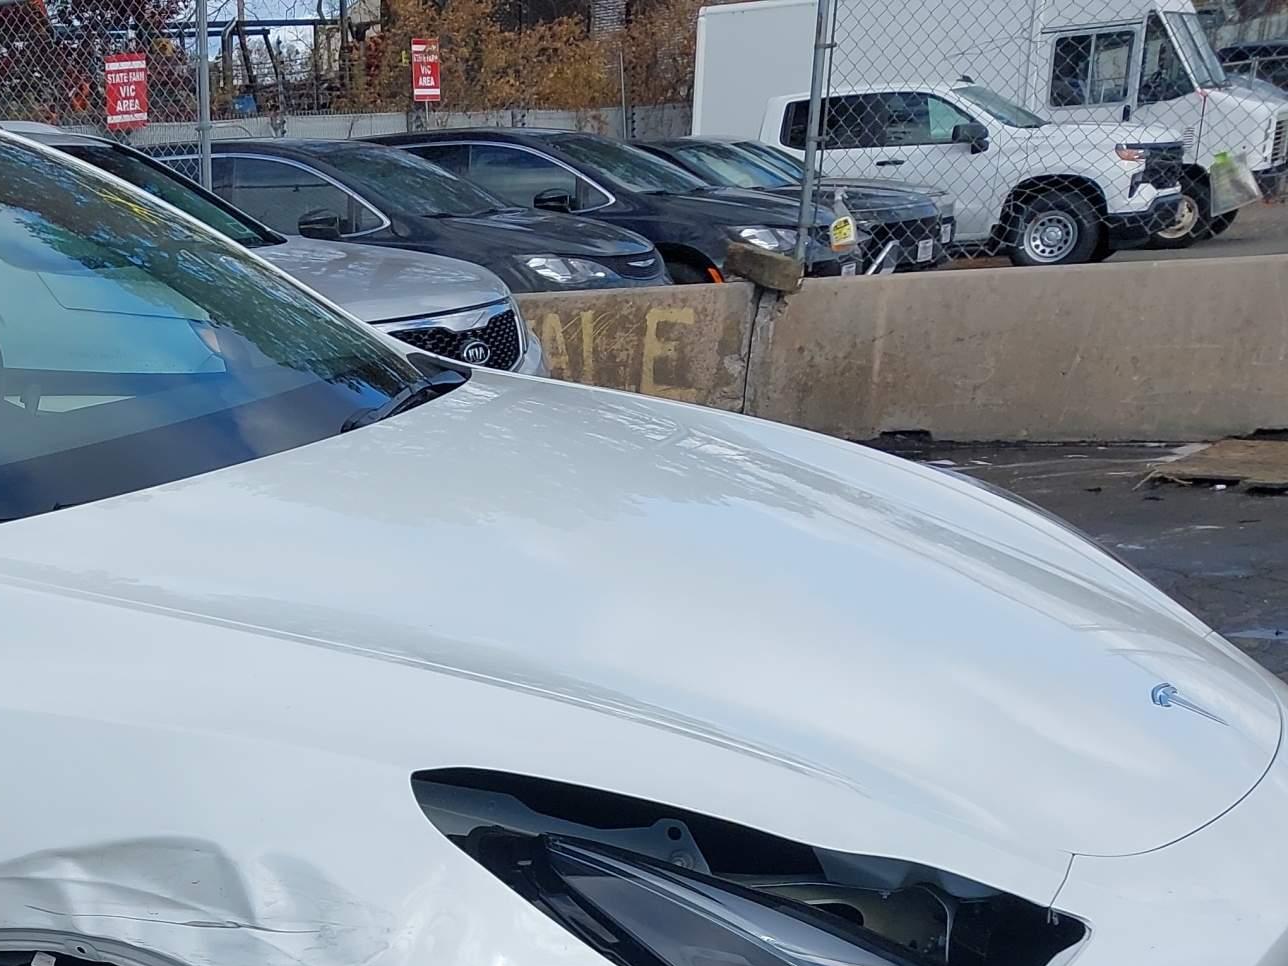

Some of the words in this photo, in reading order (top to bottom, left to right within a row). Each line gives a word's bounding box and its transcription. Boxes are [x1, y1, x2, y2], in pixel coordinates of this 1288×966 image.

[107, 73, 128, 83] STATE
[419, 76, 435, 86] AREA
[120, 85, 136, 97] VIC
[117, 100, 140, 112] AREA
